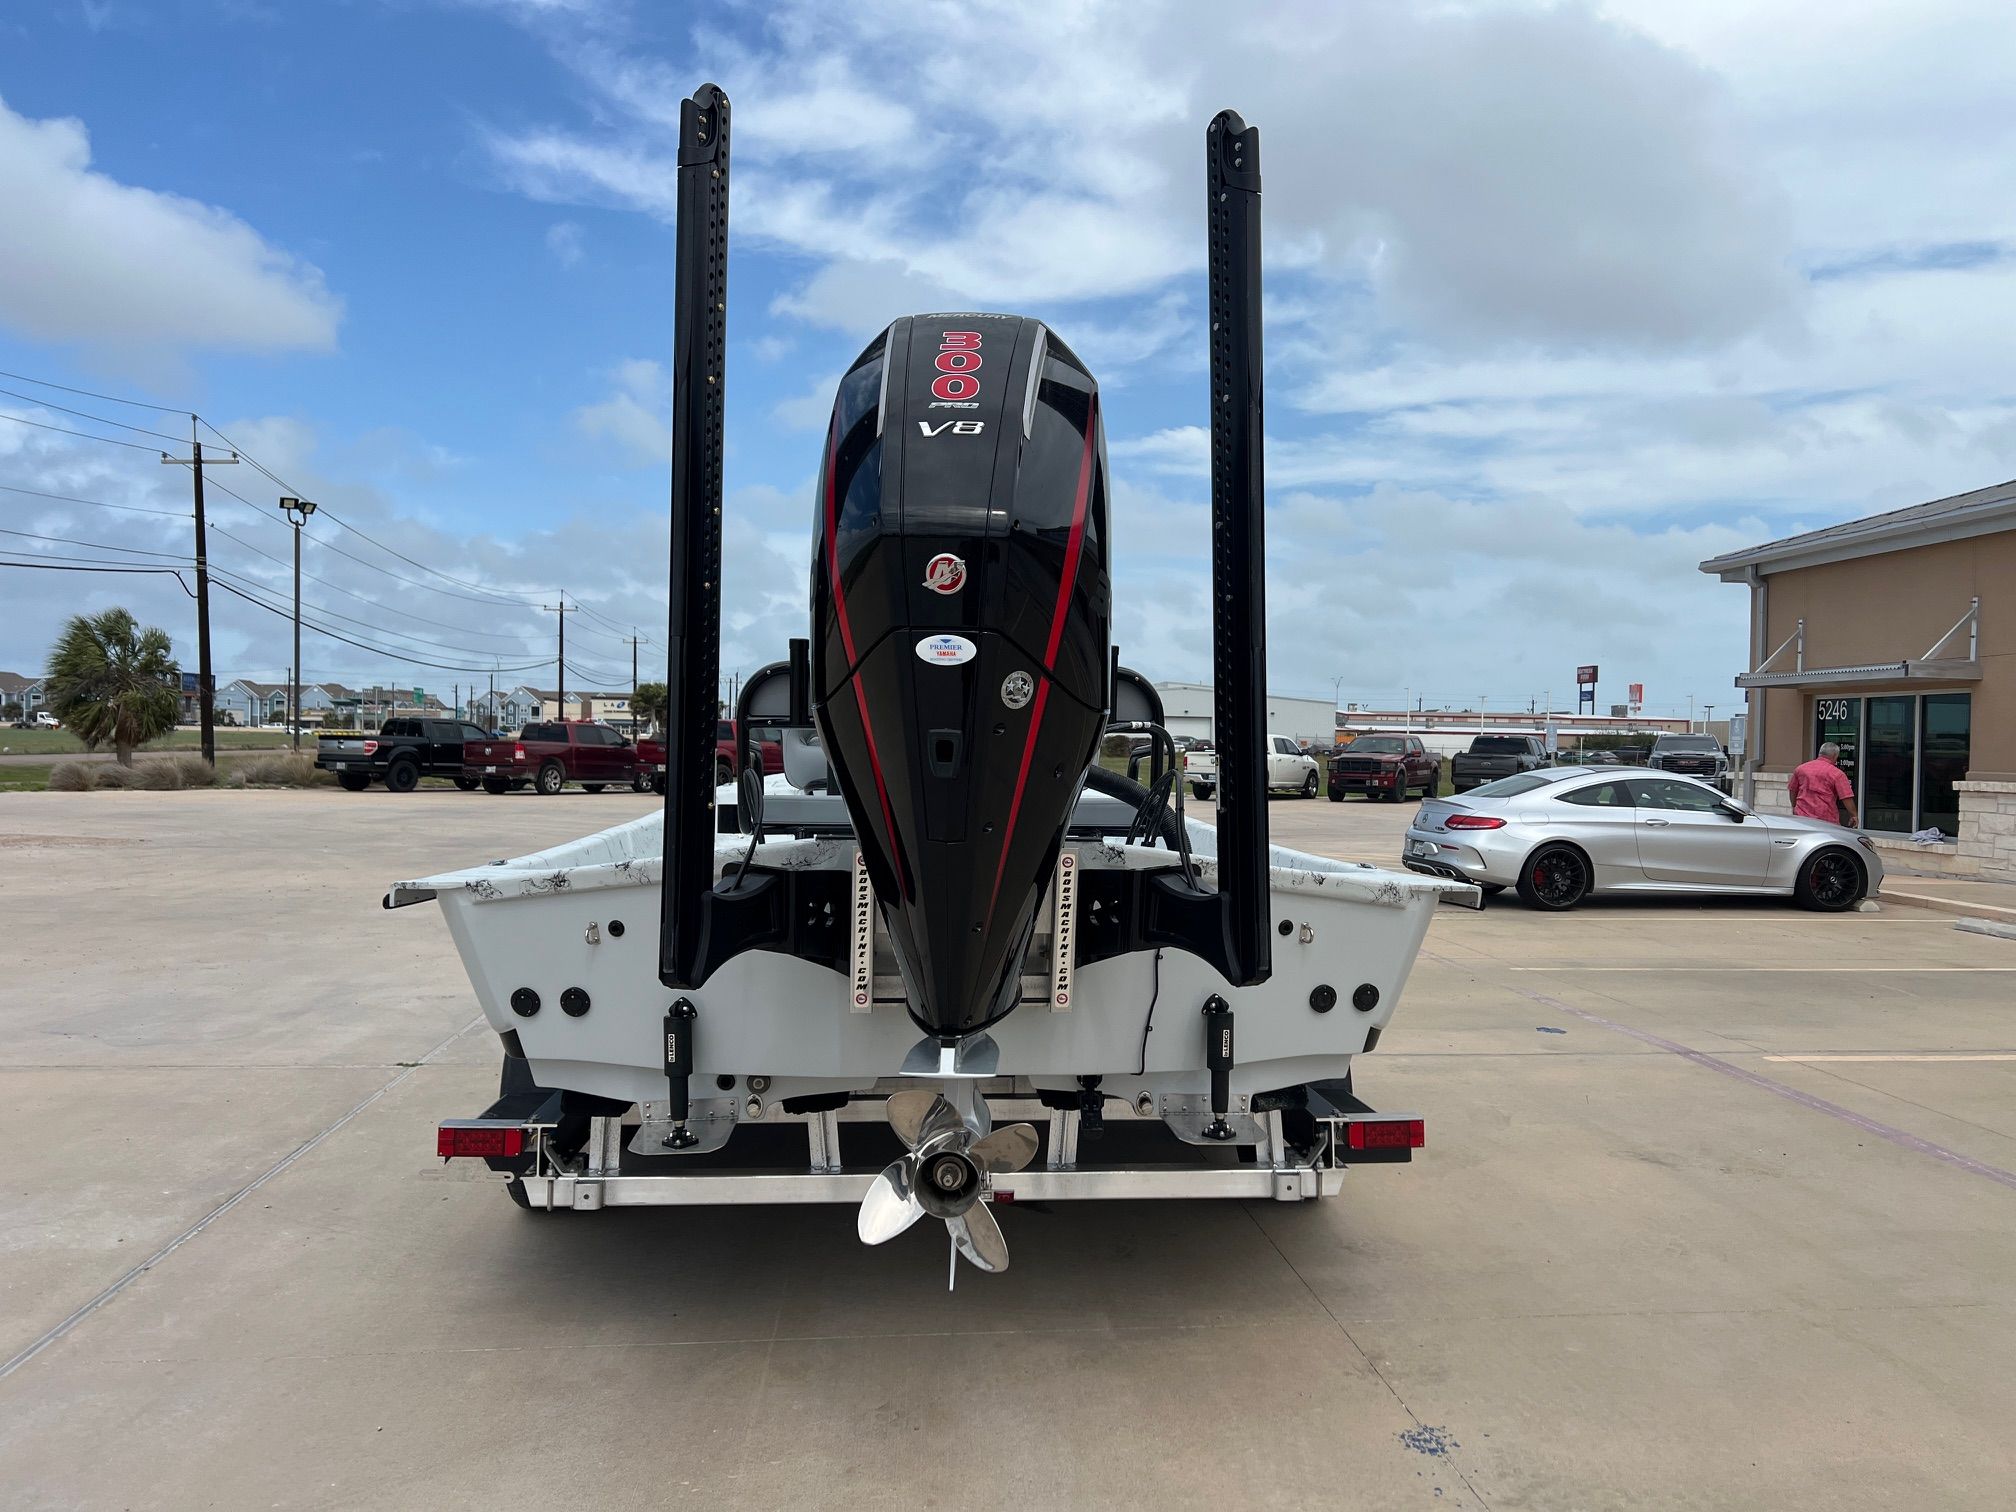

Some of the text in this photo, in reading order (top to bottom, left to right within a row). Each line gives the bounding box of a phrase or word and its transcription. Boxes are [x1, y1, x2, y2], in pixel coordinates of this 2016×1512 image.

[931, 331, 982, 400] 300
[918, 421, 985, 437] V8
[1818, 700, 1847, 720] 5246
